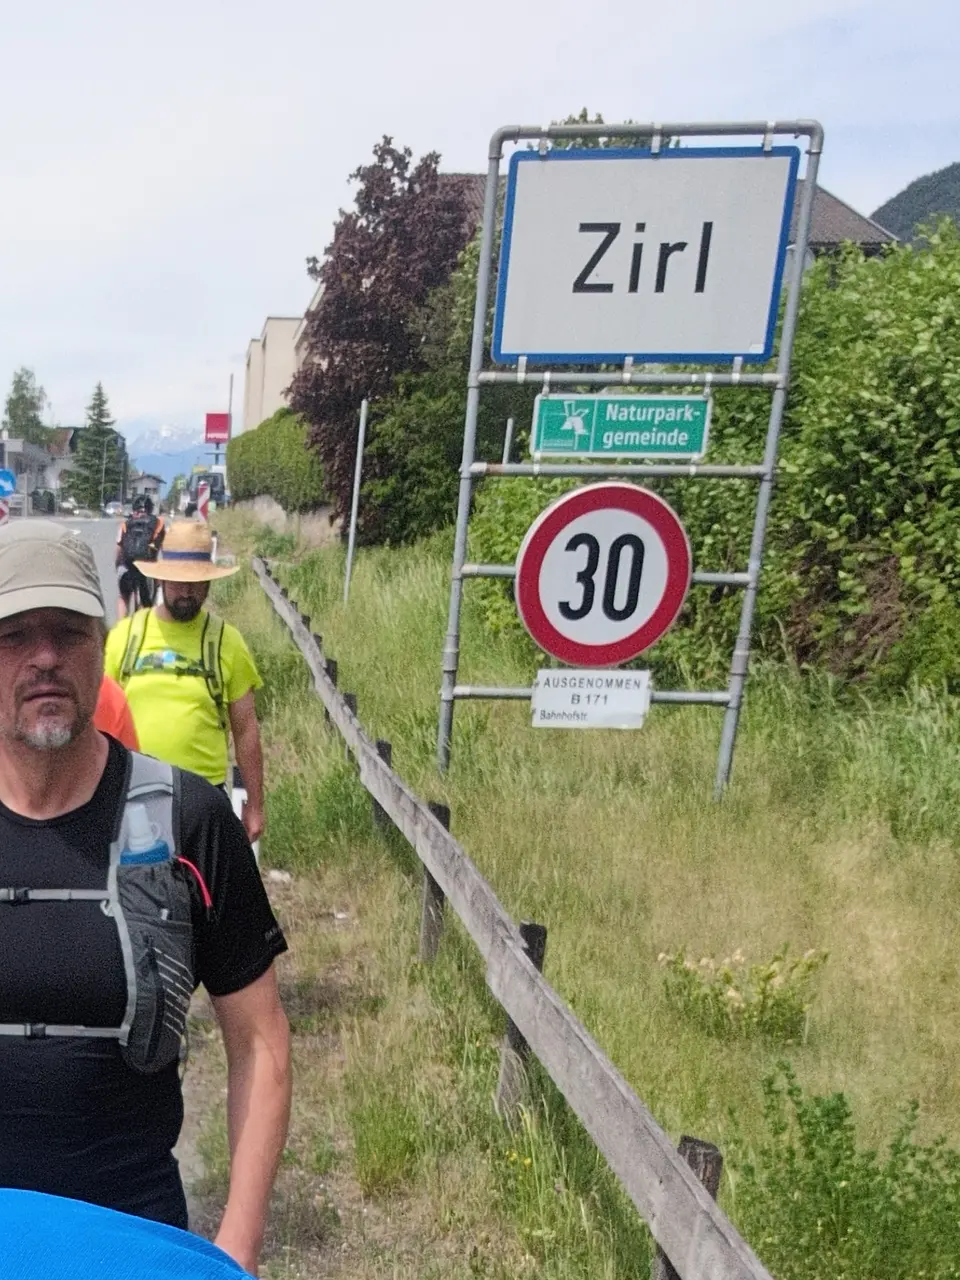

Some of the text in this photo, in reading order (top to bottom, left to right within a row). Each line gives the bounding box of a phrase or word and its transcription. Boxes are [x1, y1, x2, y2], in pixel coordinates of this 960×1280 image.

[572, 221, 713, 293] Zirl
[606, 403, 701, 424] Naturpark-
[603, 427, 688, 449] gemeinde
[558, 532, 644, 621] 30
[543, 677, 641, 690] AUSGENOMMEN
[571, 693, 608, 705] B 171
